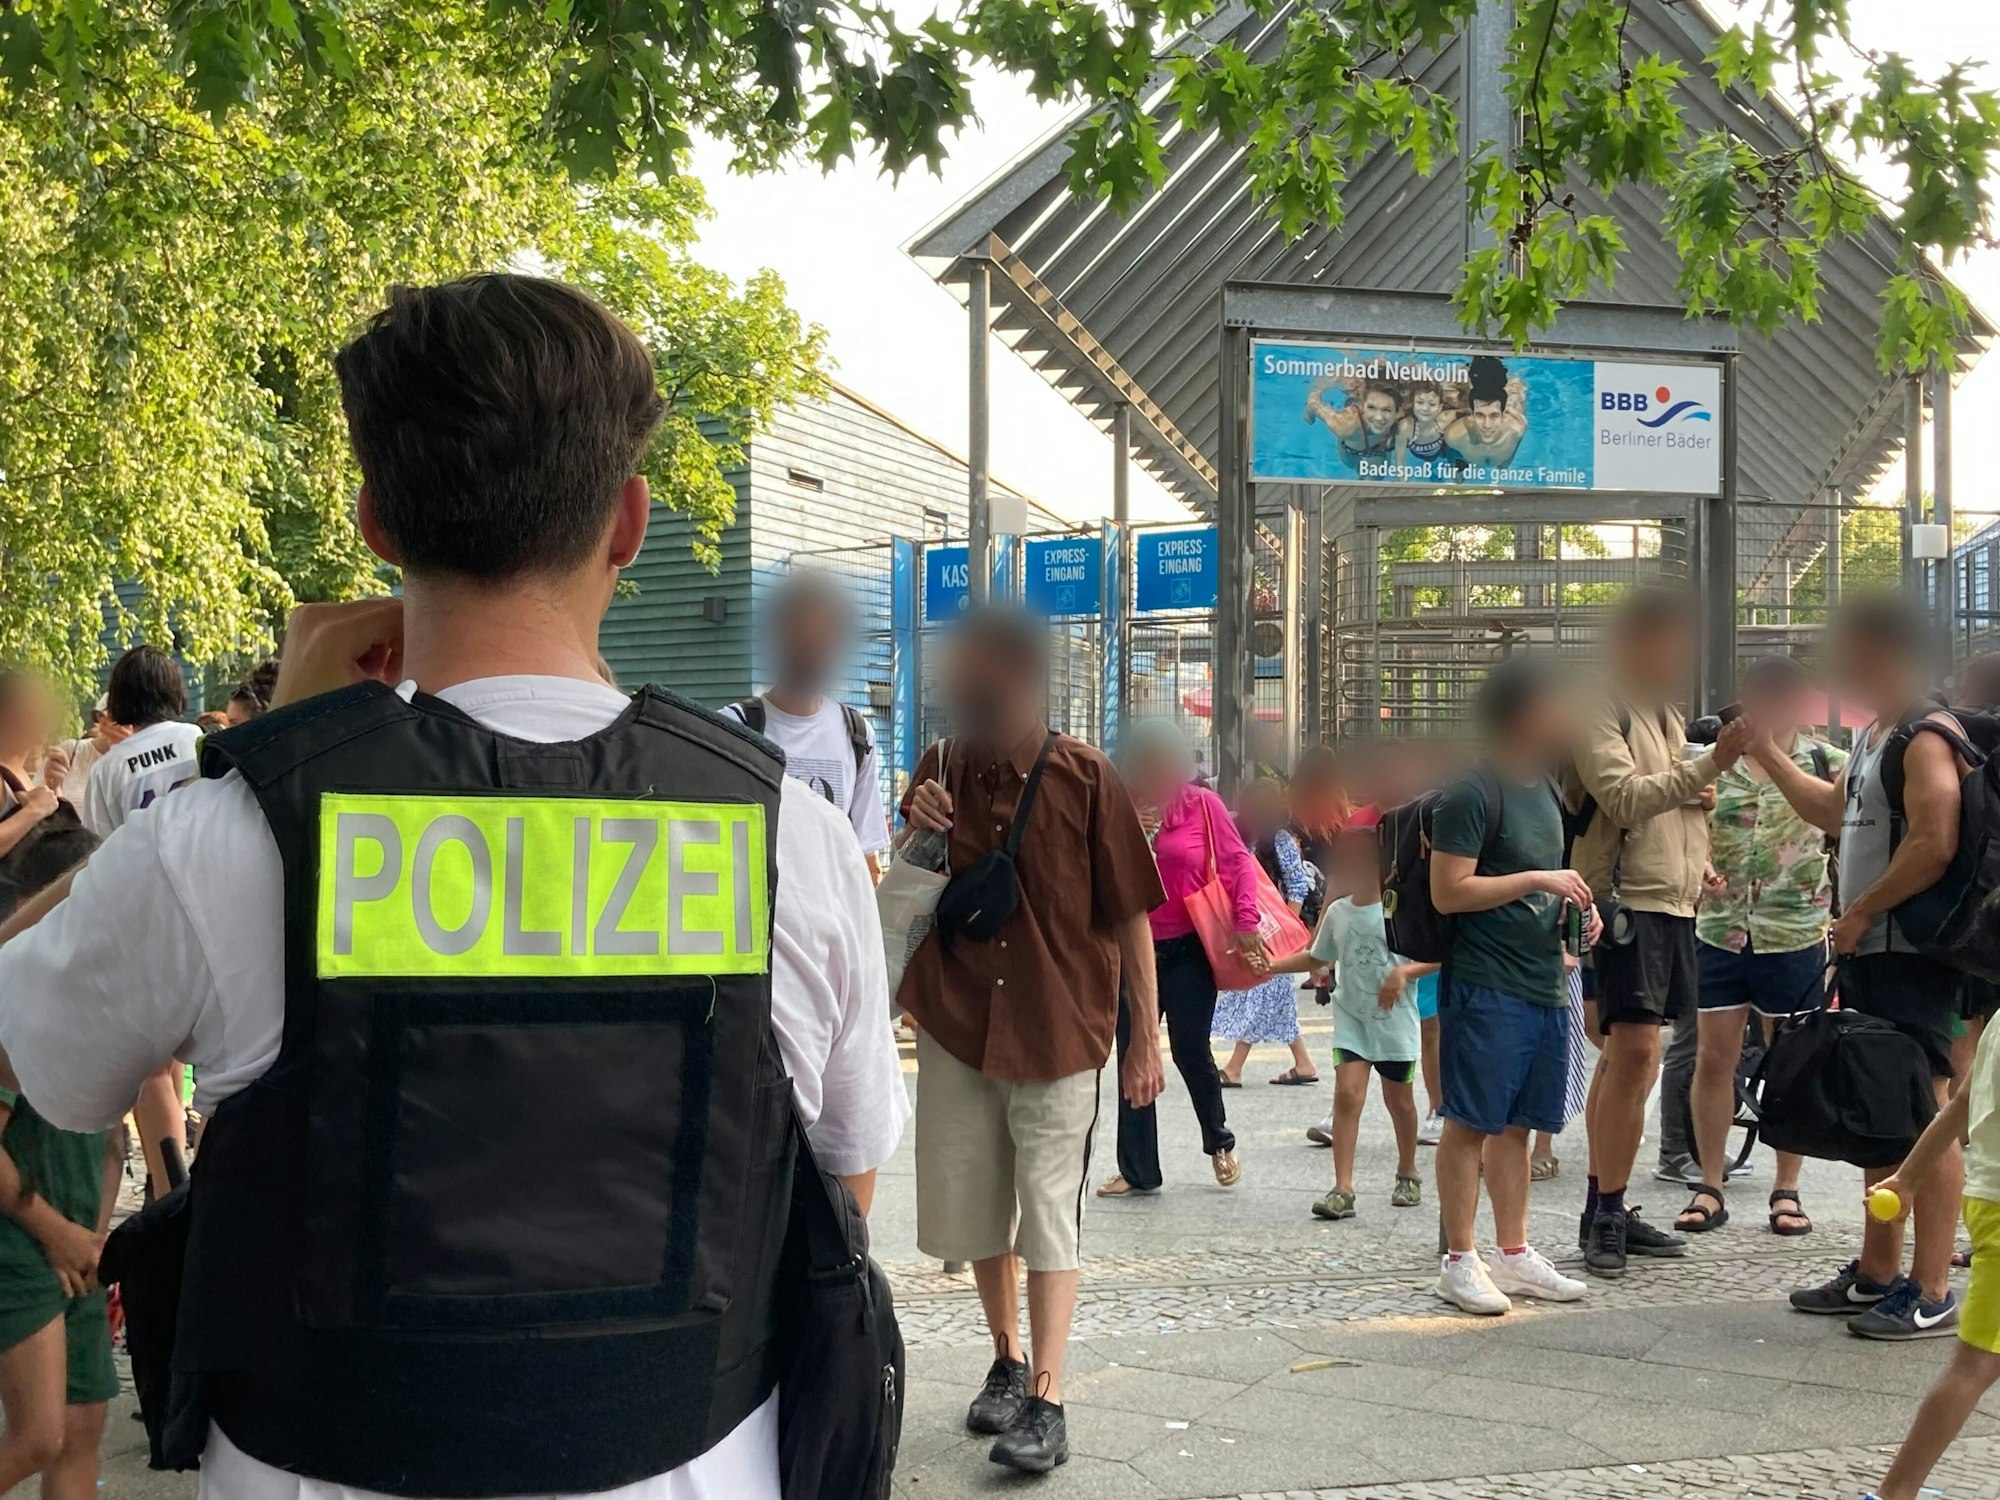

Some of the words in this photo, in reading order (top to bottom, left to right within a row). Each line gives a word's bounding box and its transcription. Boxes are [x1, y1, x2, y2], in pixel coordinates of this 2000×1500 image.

[1264, 355, 1378, 380] Sommerbad
[1385, 360, 1469, 383] Neukölln
[1601, 392, 1648, 411] BBB
[1601, 430, 1662, 447] Berliner
[1667, 432, 1711, 449] Bäder
[1359, 460, 1432, 482] Badespaß
[1436, 462, 1459, 479] für
[1463, 463, 1486, 480] die
[1490, 467, 1533, 484] ganze
[1538, 467, 1586, 484] Famile
[1044, 548, 1090, 565] EXPRESS-
[1158, 539, 1207, 557] EXPRESS-
[942, 564, 969, 588] KAS
[1045, 565, 1085, 582] EINGANG
[1159, 558, 1202, 575] EINGANG
[127, 743, 177, 773] PUNK
[333, 812, 753, 957] POLIZEI
